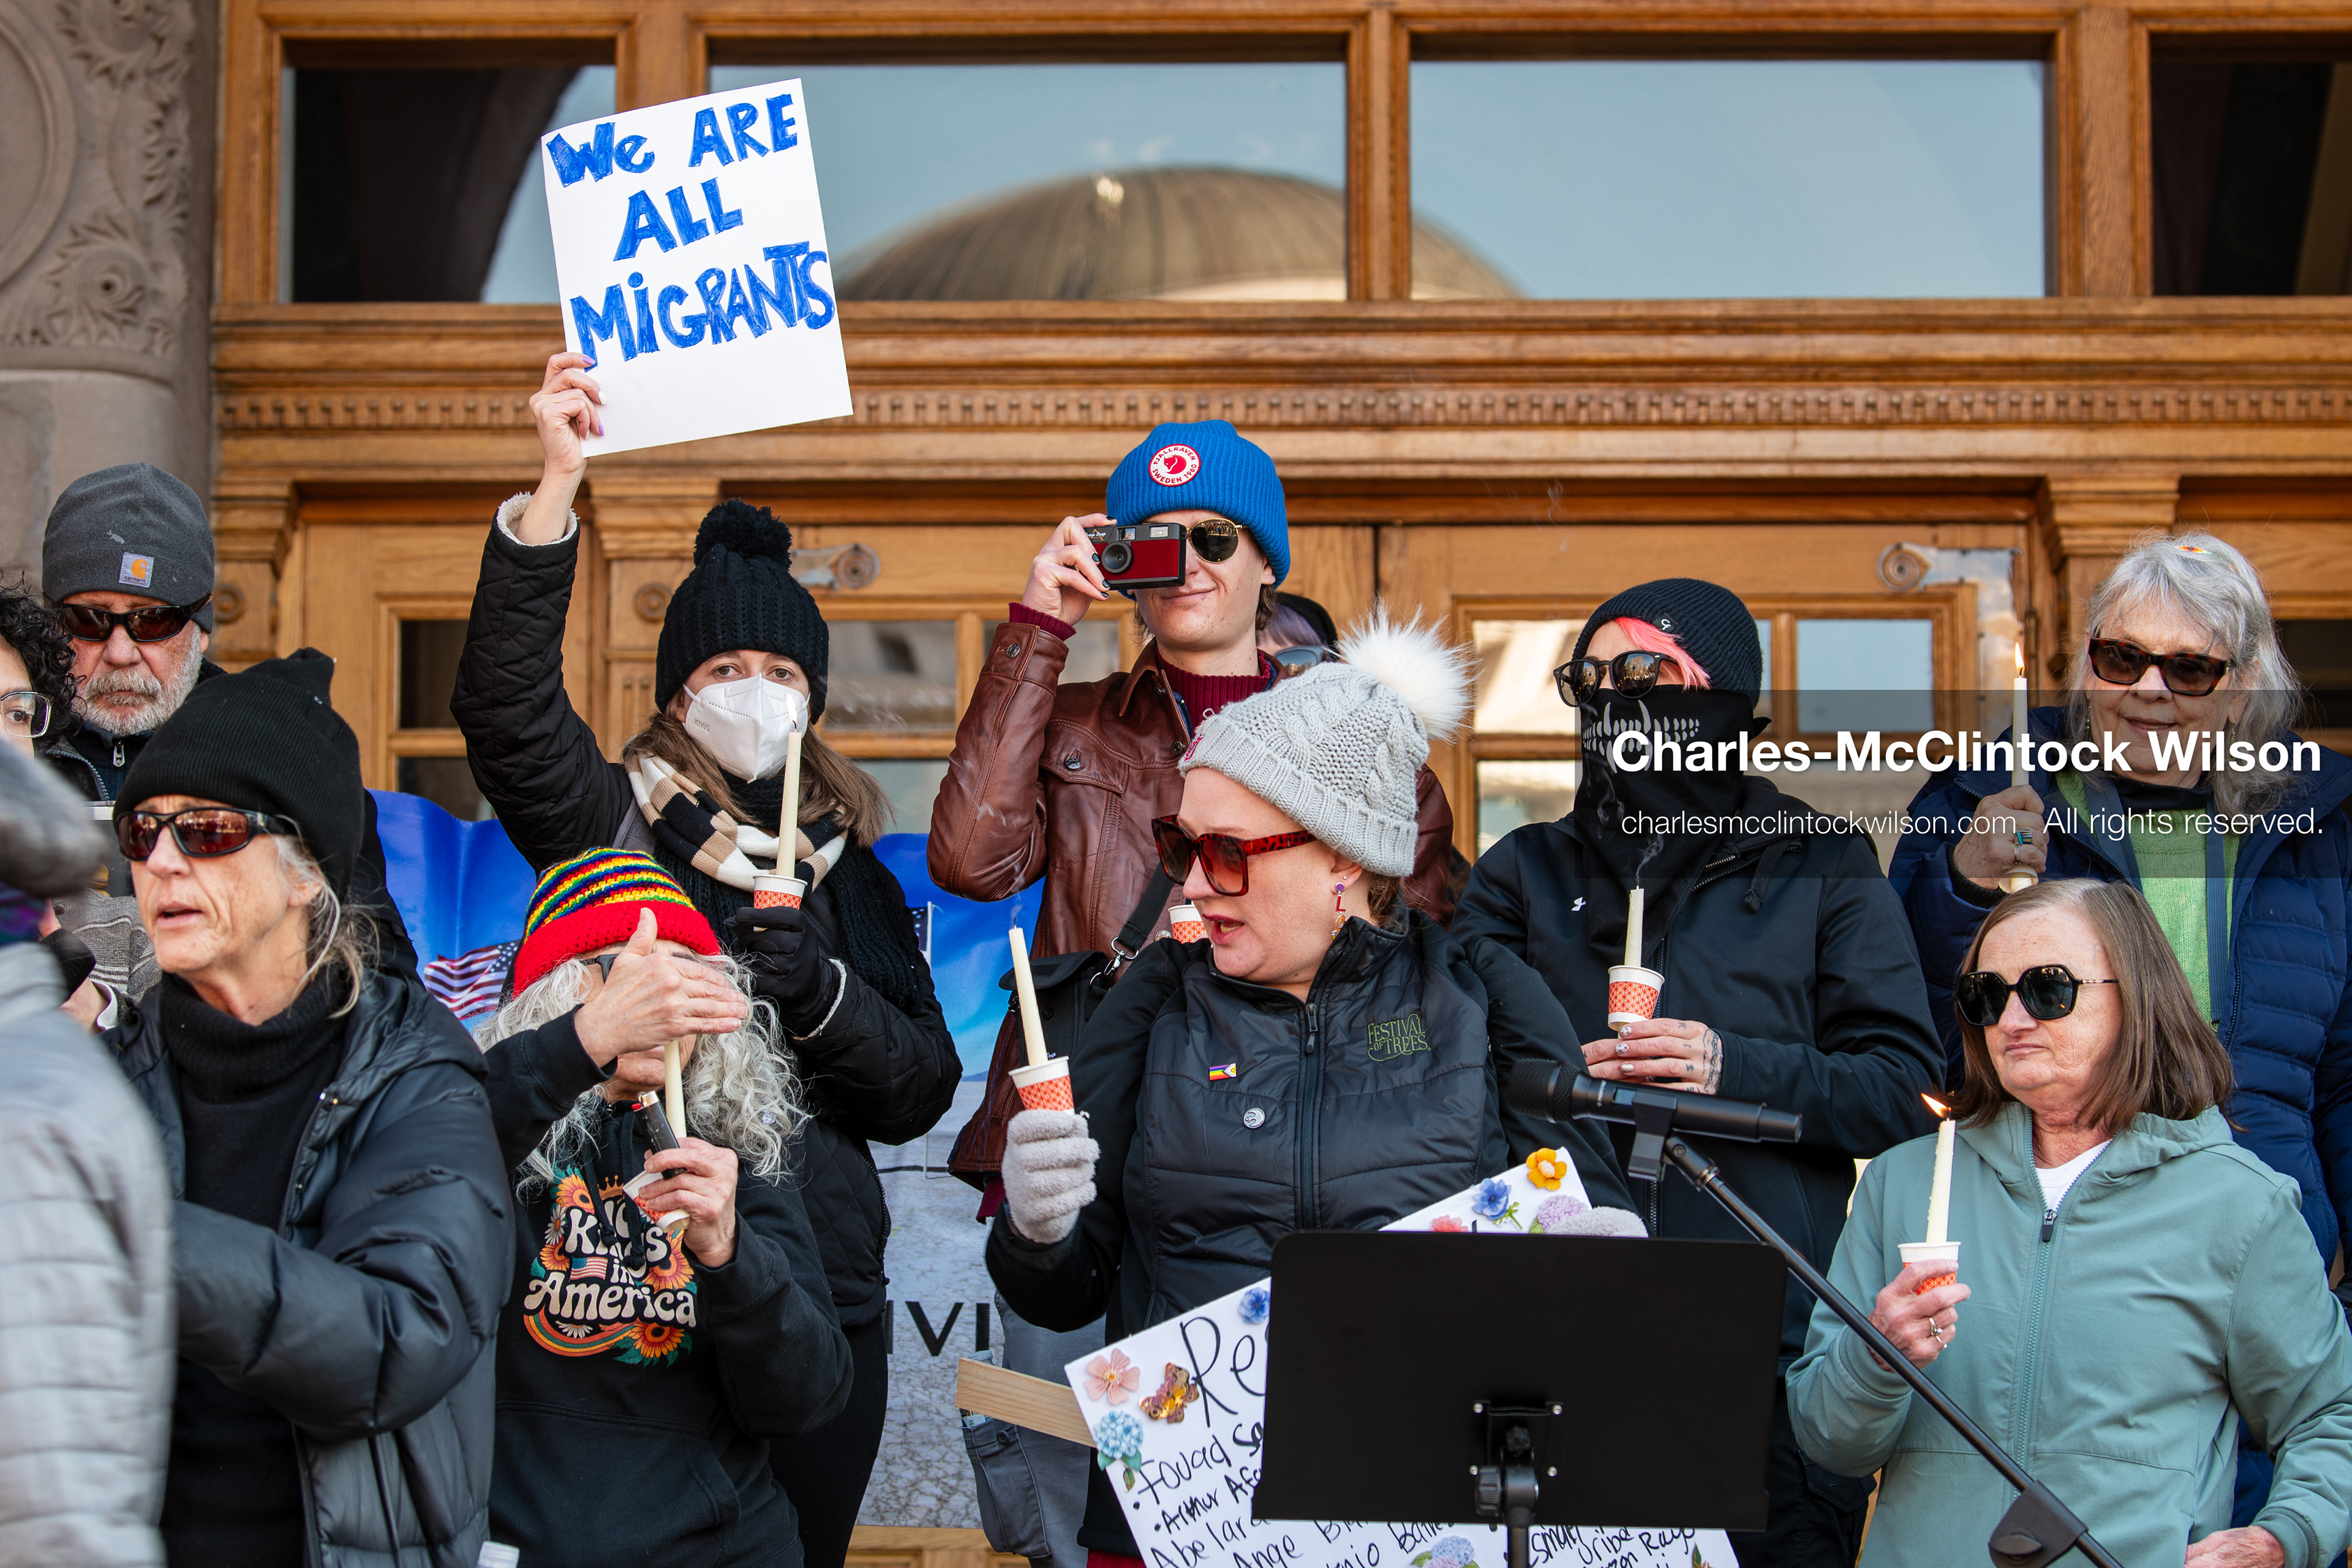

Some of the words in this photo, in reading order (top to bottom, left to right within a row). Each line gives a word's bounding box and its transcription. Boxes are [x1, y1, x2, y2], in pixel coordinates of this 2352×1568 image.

[546, 122, 655, 188] We
[688, 93, 797, 168] ARE
[613, 176, 744, 262] ALL
[1153, 469, 1183, 484] SWEDEN
[1183, 464, 1197, 479] 1960
[694, 718, 710, 732] KN95
[1367, 1014, 1426, 1045] FESTIVAL
[1373, 1041, 1384, 1051] OF
[610, 1257, 635, 1285] in
[524, 1272, 697, 1328] America
